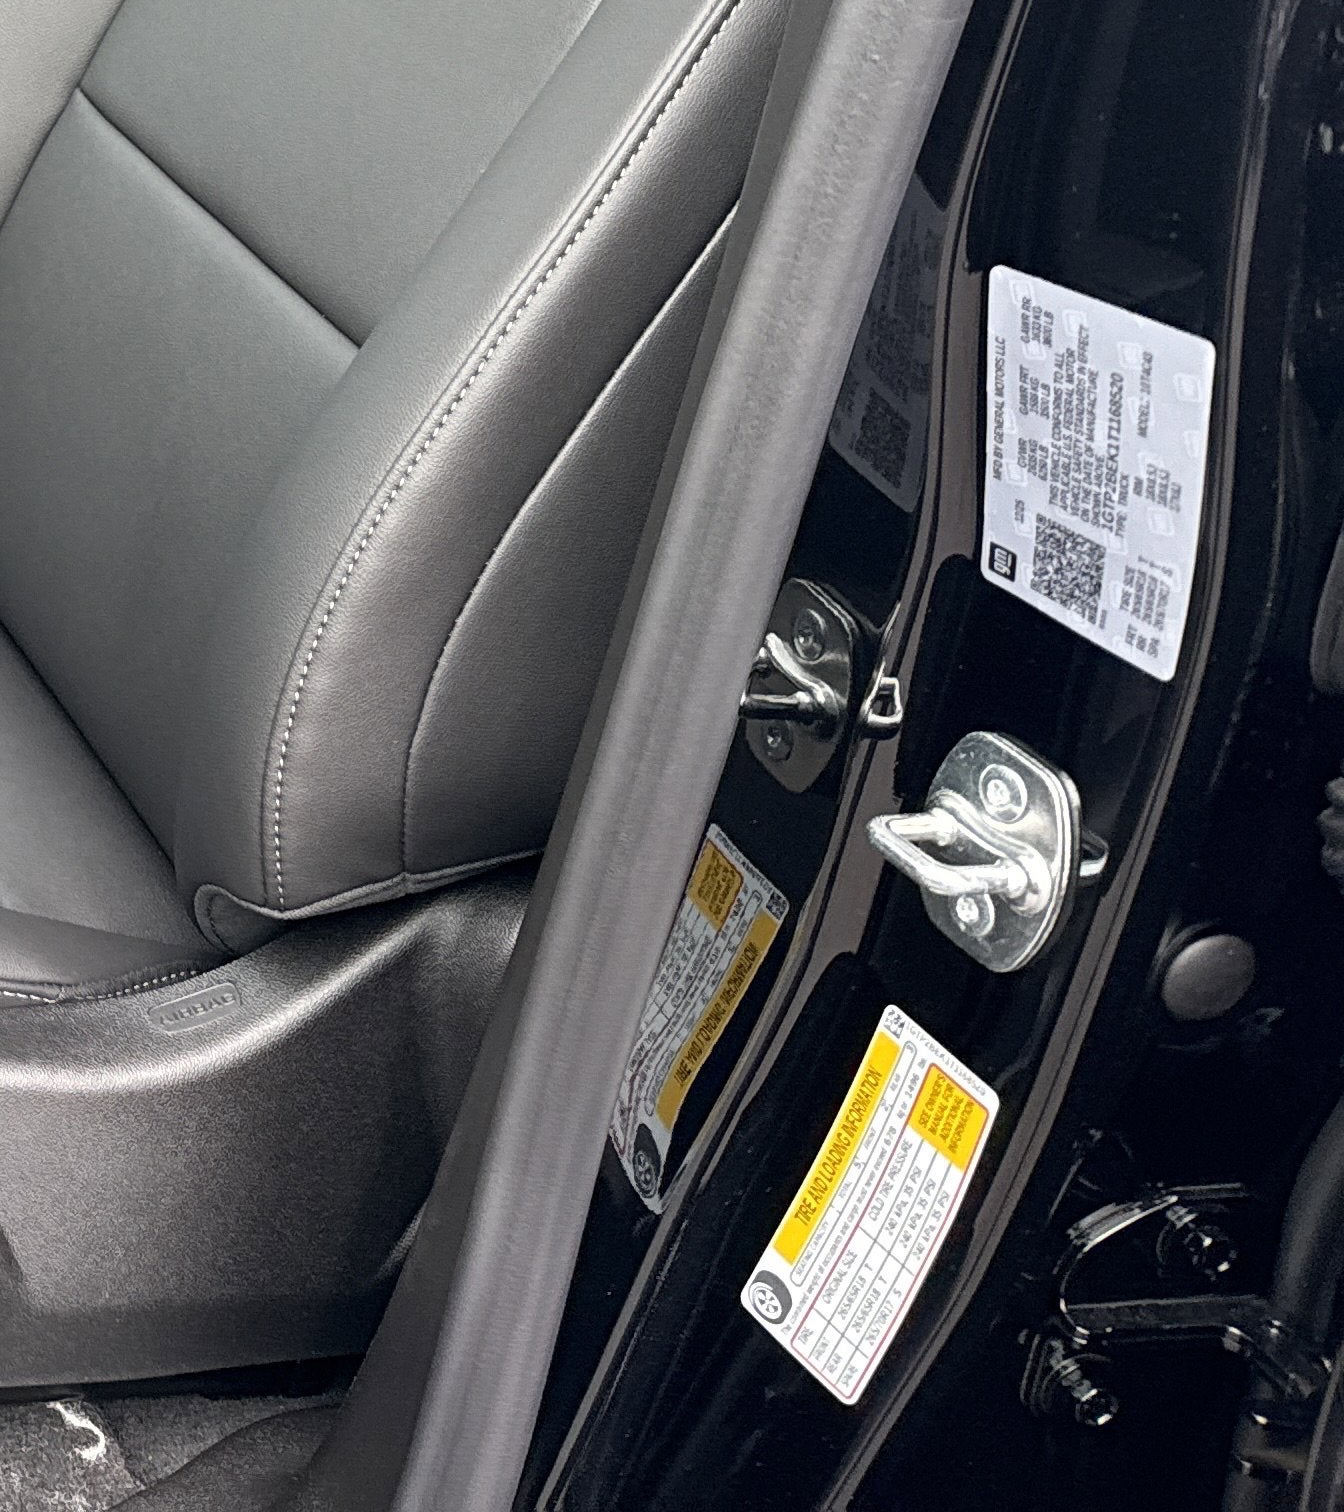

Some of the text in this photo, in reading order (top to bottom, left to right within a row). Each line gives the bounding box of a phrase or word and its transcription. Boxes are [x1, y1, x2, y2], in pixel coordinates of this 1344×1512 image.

[1020, 312, 1030, 345] GAWR
[1076, 323, 1089, 364] EFFECT
[1019, 363, 1029, 385] FRT
[1029, 375, 1039, 392] KG
[1038, 309, 1053, 459] LB LB LB
[992, 334, 1004, 481] MFD BY GENERAL MOTORS LLC
[1018, 384, 1028, 416] GAWR
[1073, 374, 1085, 436] STANDARDS
[1048, 349, 1064, 507] THIS VEHICLE CONFORMS TO ALL
[1059, 346, 1075, 512] APPLICABLE U.S. FEDERAL MOTOR
[1080, 367, 1098, 523] ON THE DATE OF MANUFACTURE
[1071, 435, 1083, 476] SAFETY
[1070, 474, 1080, 517] VEHICLE
[1090, 489, 1101, 528] SHOWN
[1118, 470, 1129, 507] TRUCK
[993, 544, 1011, 578] gm
[159, 992, 236, 1025] AIRBAG
[883, 1124, 897, 1147] 678
[904, 1071, 920, 1099] 1496
[917, 1107, 931, 1129] SEE
[928, 1081, 955, 1136] MANUAL FOR
[938, 1092, 964, 1143] ADDITIONAL
[947, 1098, 975, 1154] INFORMATION
[793, 1063, 883, 1228] TIRE AND LOADING INFORMATION
[908, 1164, 922, 1184] PSI
[922, 1176, 937, 1197] PSI
[936, 1188, 950, 1209] PSI
[797, 1137, 913, 1347] TIRE ORIGINAL SIZE COLD TIRE PRESSURE
